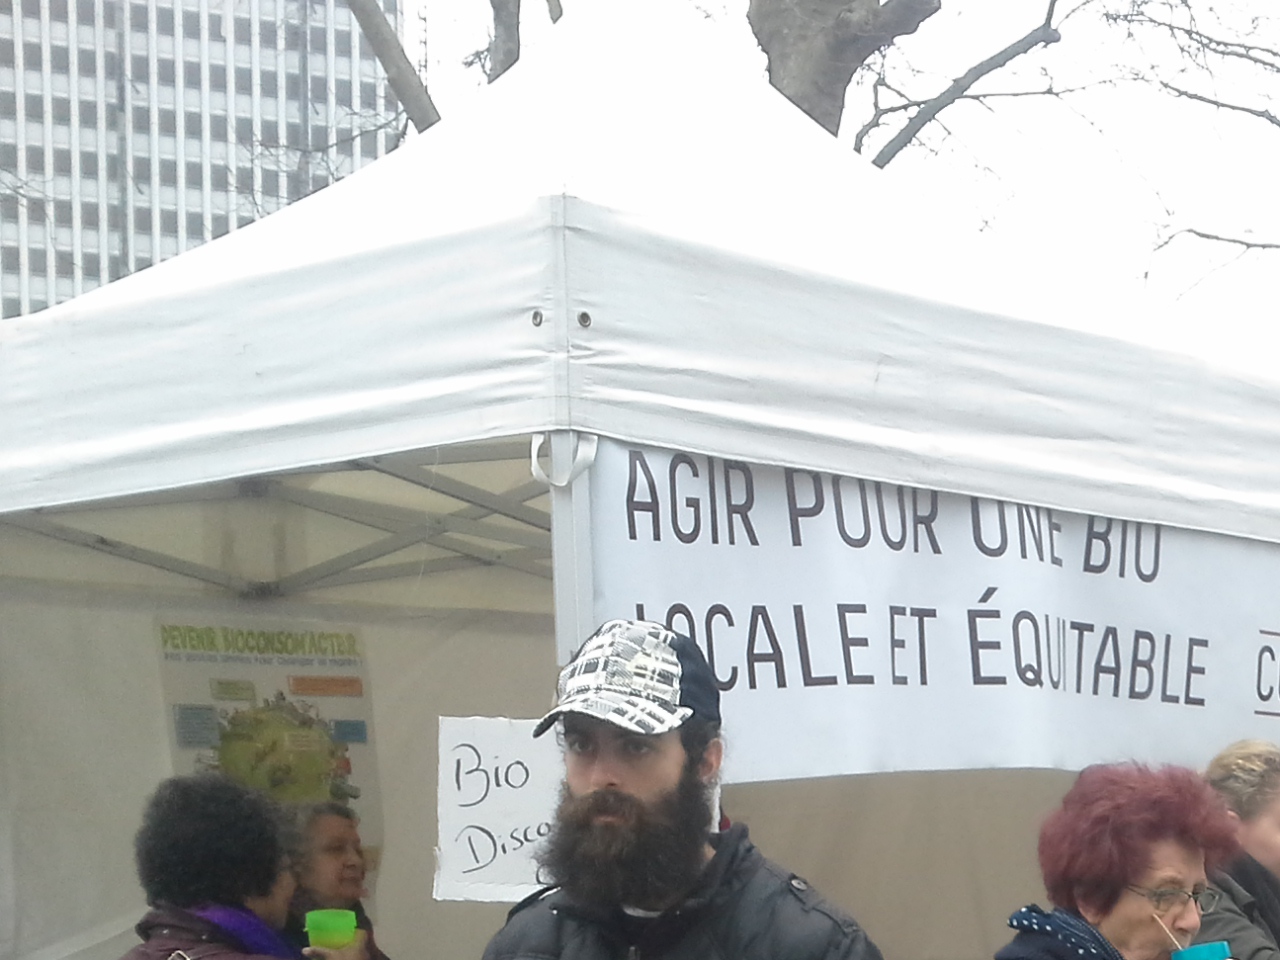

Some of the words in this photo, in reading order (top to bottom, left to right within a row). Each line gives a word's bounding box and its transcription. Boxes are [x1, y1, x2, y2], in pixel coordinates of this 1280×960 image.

[626, 450, 760, 547] AGIR
[784, 467, 943, 555] POUR
[635, 602, 875, 692] CALE
[889, 604, 938, 687] ET
[966, 586, 1210, 707] ÉQUITABLE
[451, 743, 530, 808] Bio
